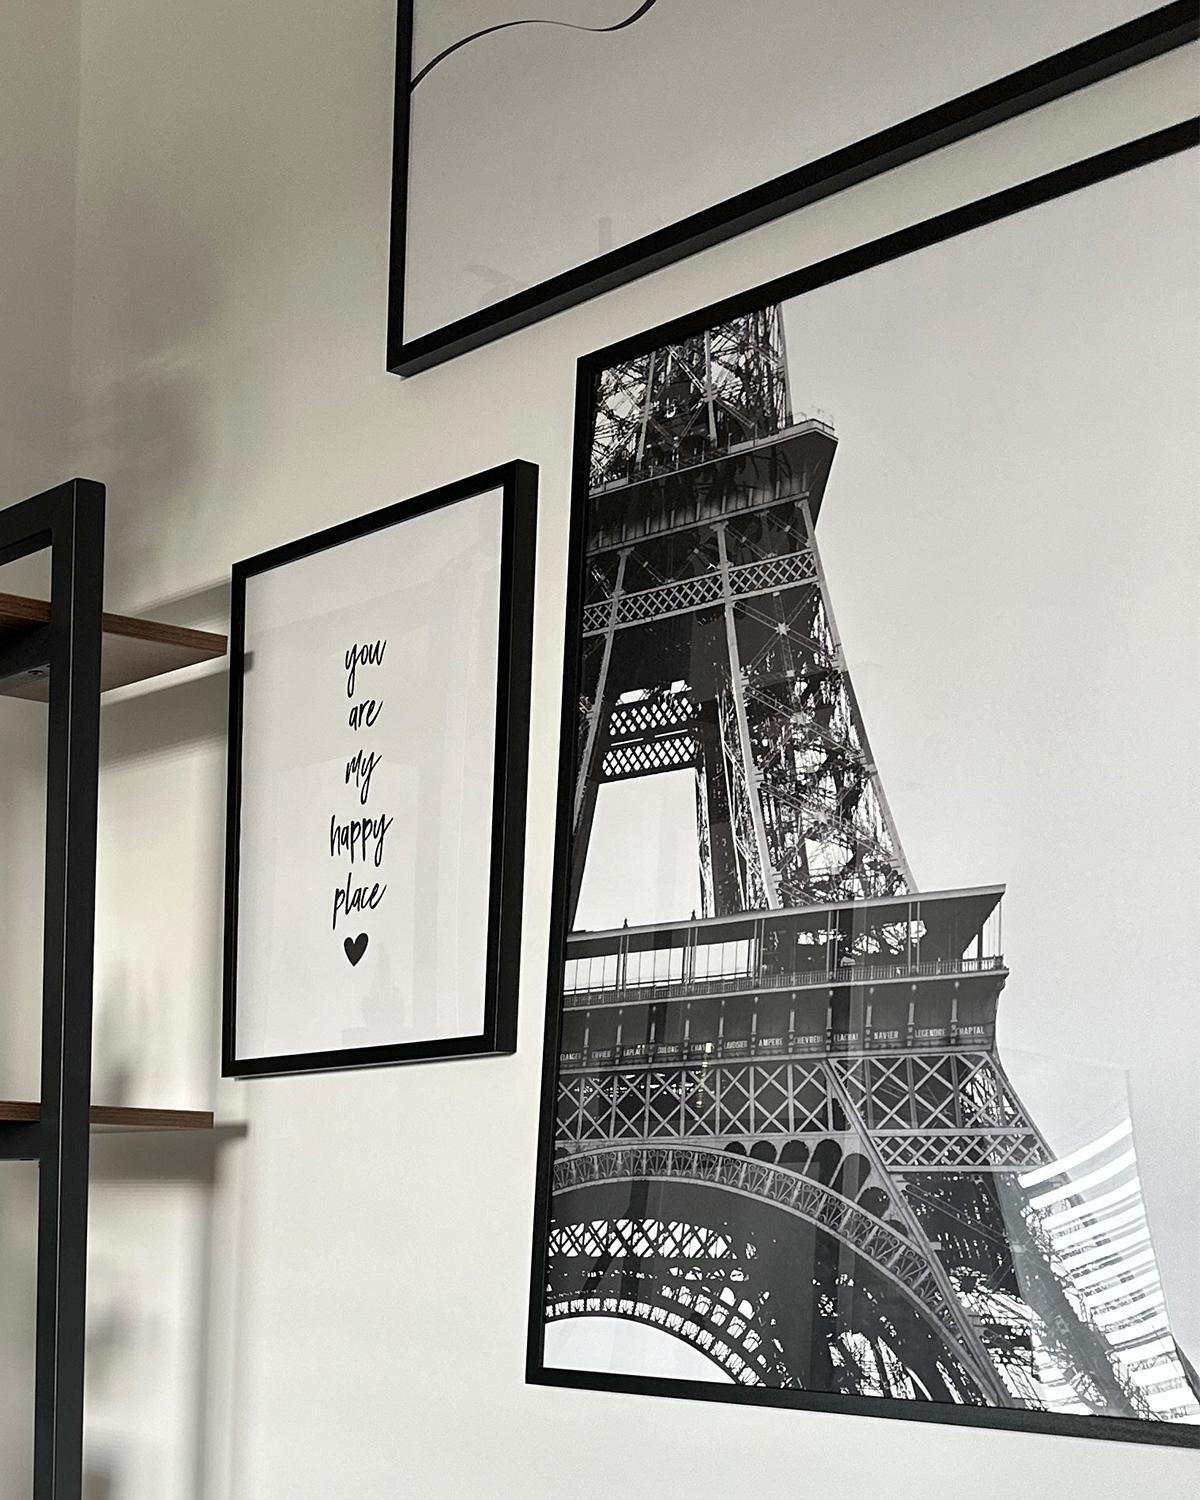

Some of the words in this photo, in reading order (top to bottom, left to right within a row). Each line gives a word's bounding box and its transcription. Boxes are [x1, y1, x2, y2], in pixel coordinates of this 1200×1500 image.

[345, 640, 386, 698] you
[349, 700, 383, 731] are
[346, 750, 382, 805] my
[331, 814, 393, 867] happy
[333, 872, 386, 930] place
[873, 1030, 899, 1040] NAVIER
